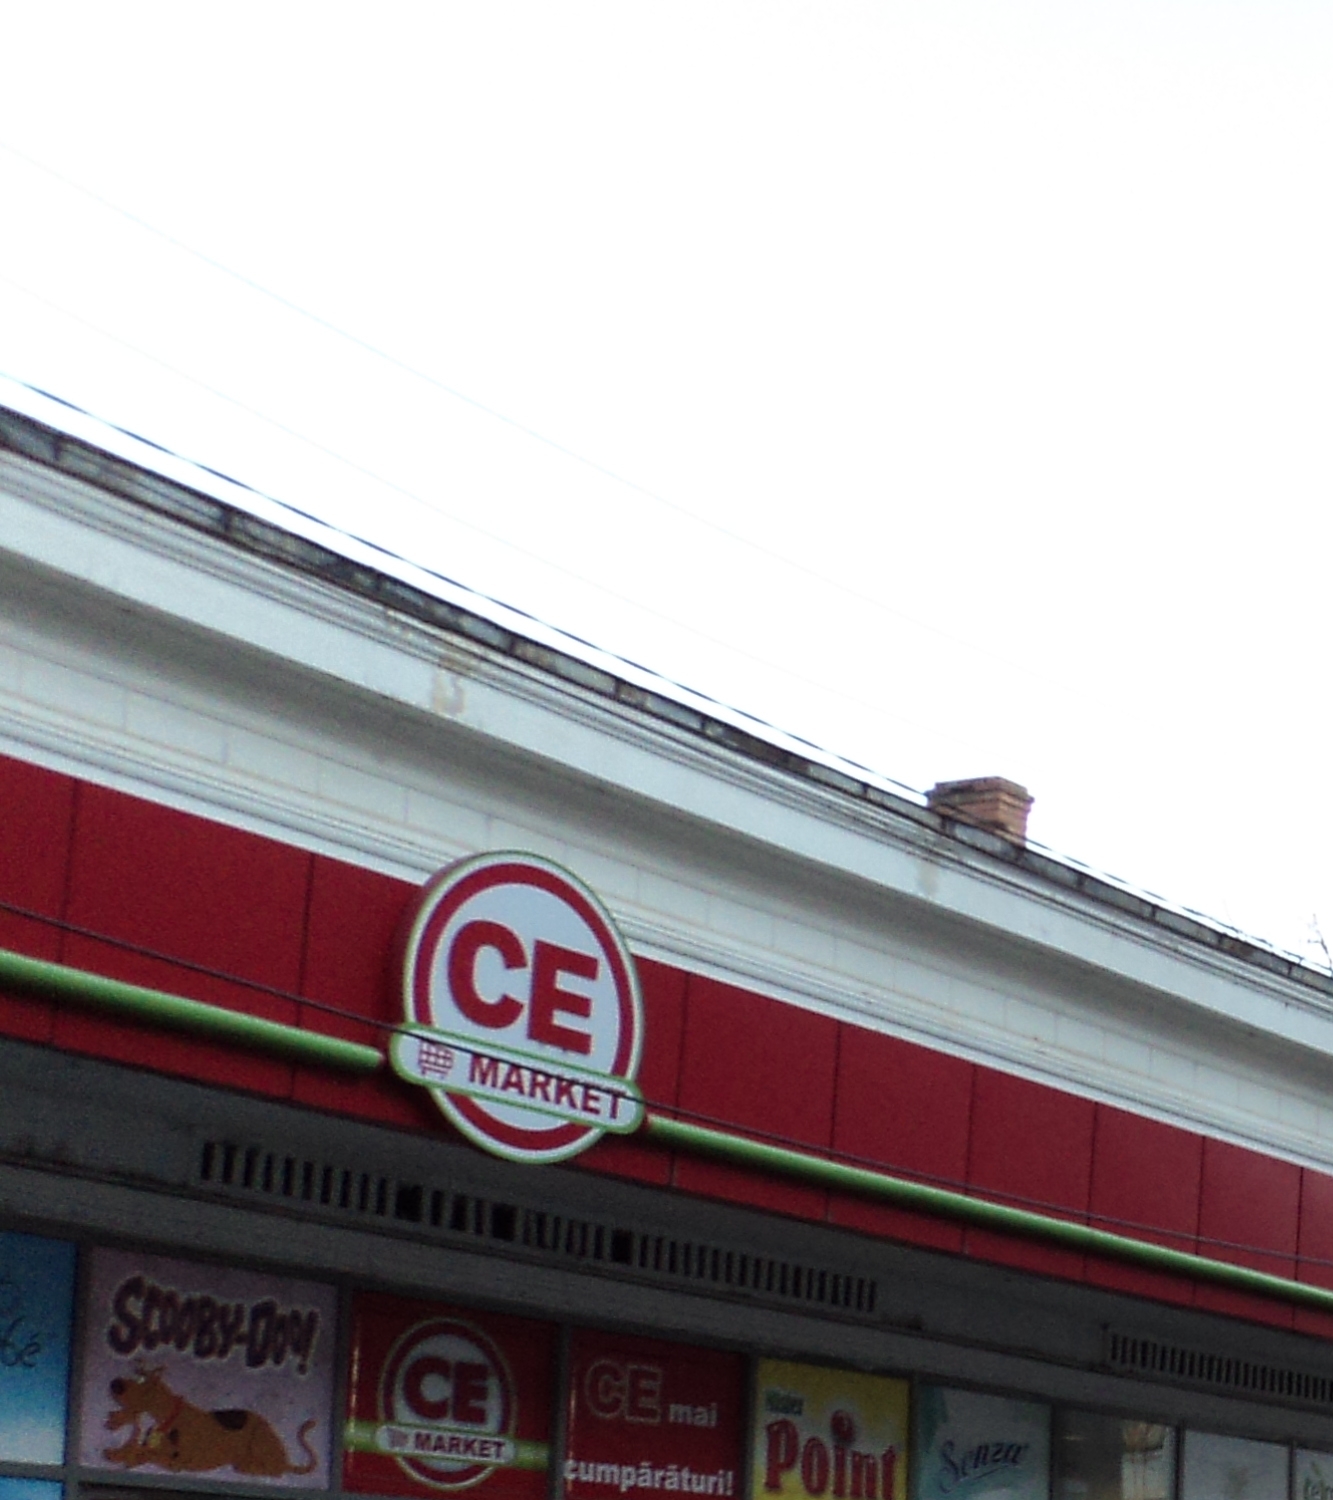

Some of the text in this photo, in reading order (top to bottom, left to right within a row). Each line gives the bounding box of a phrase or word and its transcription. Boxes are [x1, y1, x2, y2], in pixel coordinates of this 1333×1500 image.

[448, 920, 599, 1056] CE
[468, 1052, 627, 1119] MARKET
[402, 1356, 490, 1425] CE
[584, 1359, 662, 1424] CE
[668, 1402, 718, 1427] mai
[414, 1431, 505, 1460] MARKET
